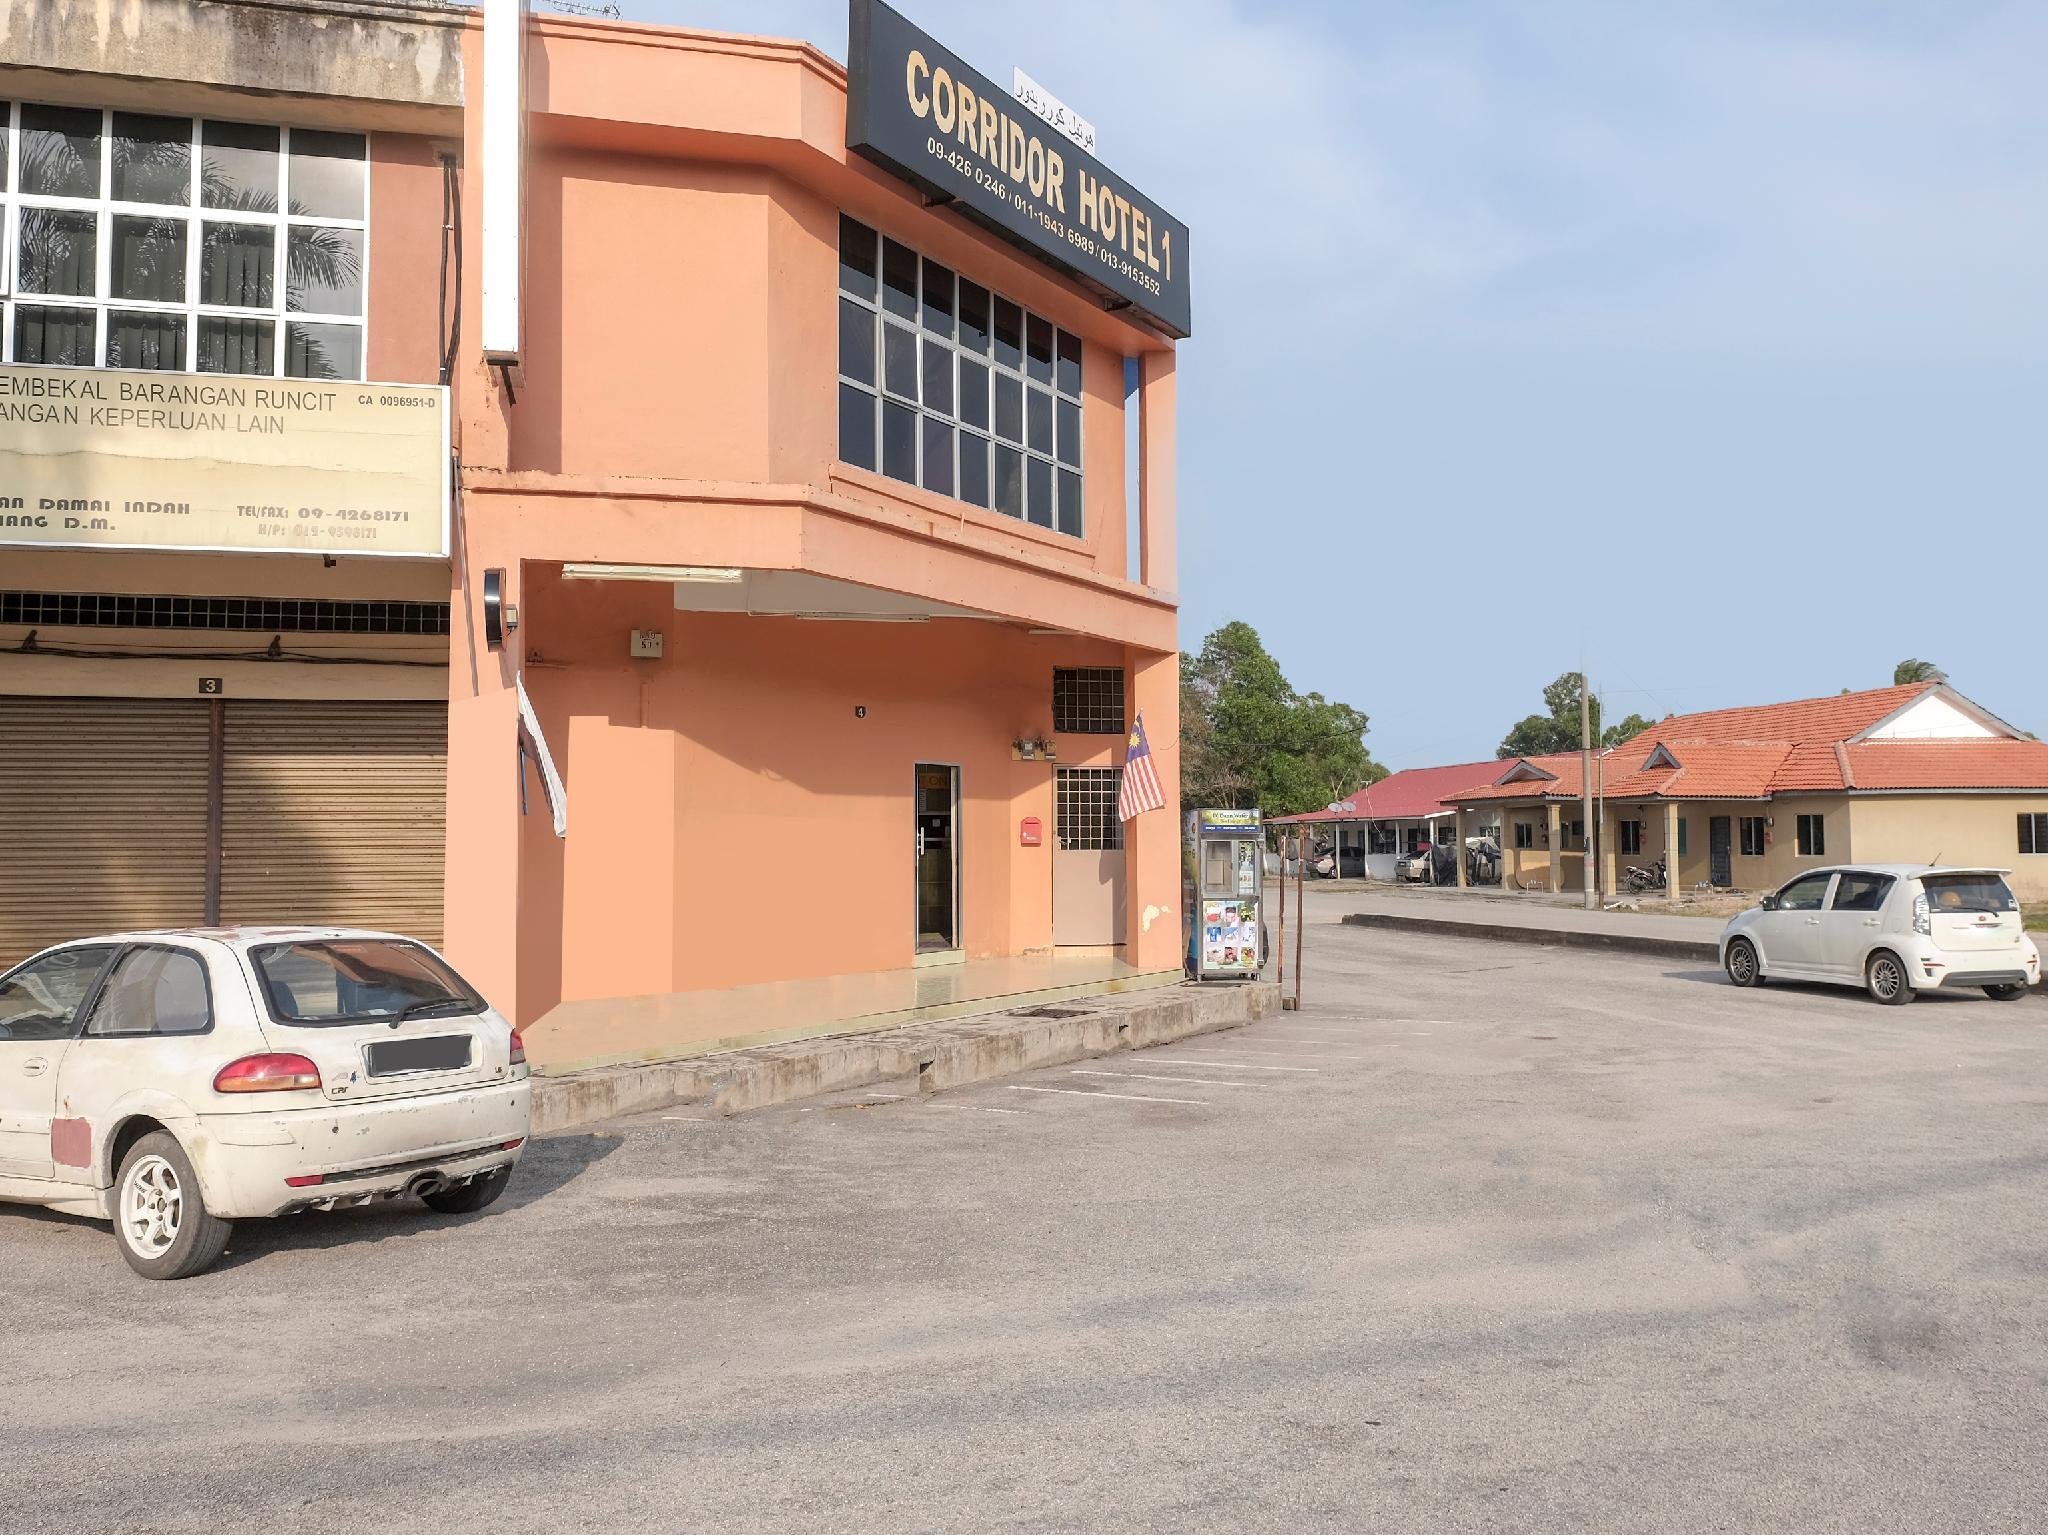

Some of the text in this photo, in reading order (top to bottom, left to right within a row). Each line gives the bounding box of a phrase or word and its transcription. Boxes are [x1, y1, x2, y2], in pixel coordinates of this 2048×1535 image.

[906, 50, 1066, 214] CORRIDOR
[927, 137, 972, 177] 09-426
[1014, 194, 1064, 238] 011-1943
[1067, 228, 1095, 255] 6989
[1101, 248, 1160, 296] 013-9153552
[120, 382, 246, 408] BARANGAN
[255, 389, 337, 412] RUNCIT
[358, 395, 373, 405] CA
[91, 407, 226, 431] KEPERLUAN
[237, 413, 284, 434] LAIN
[206, 679, 216, 693] 3
[858, 707, 864, 718] 4
